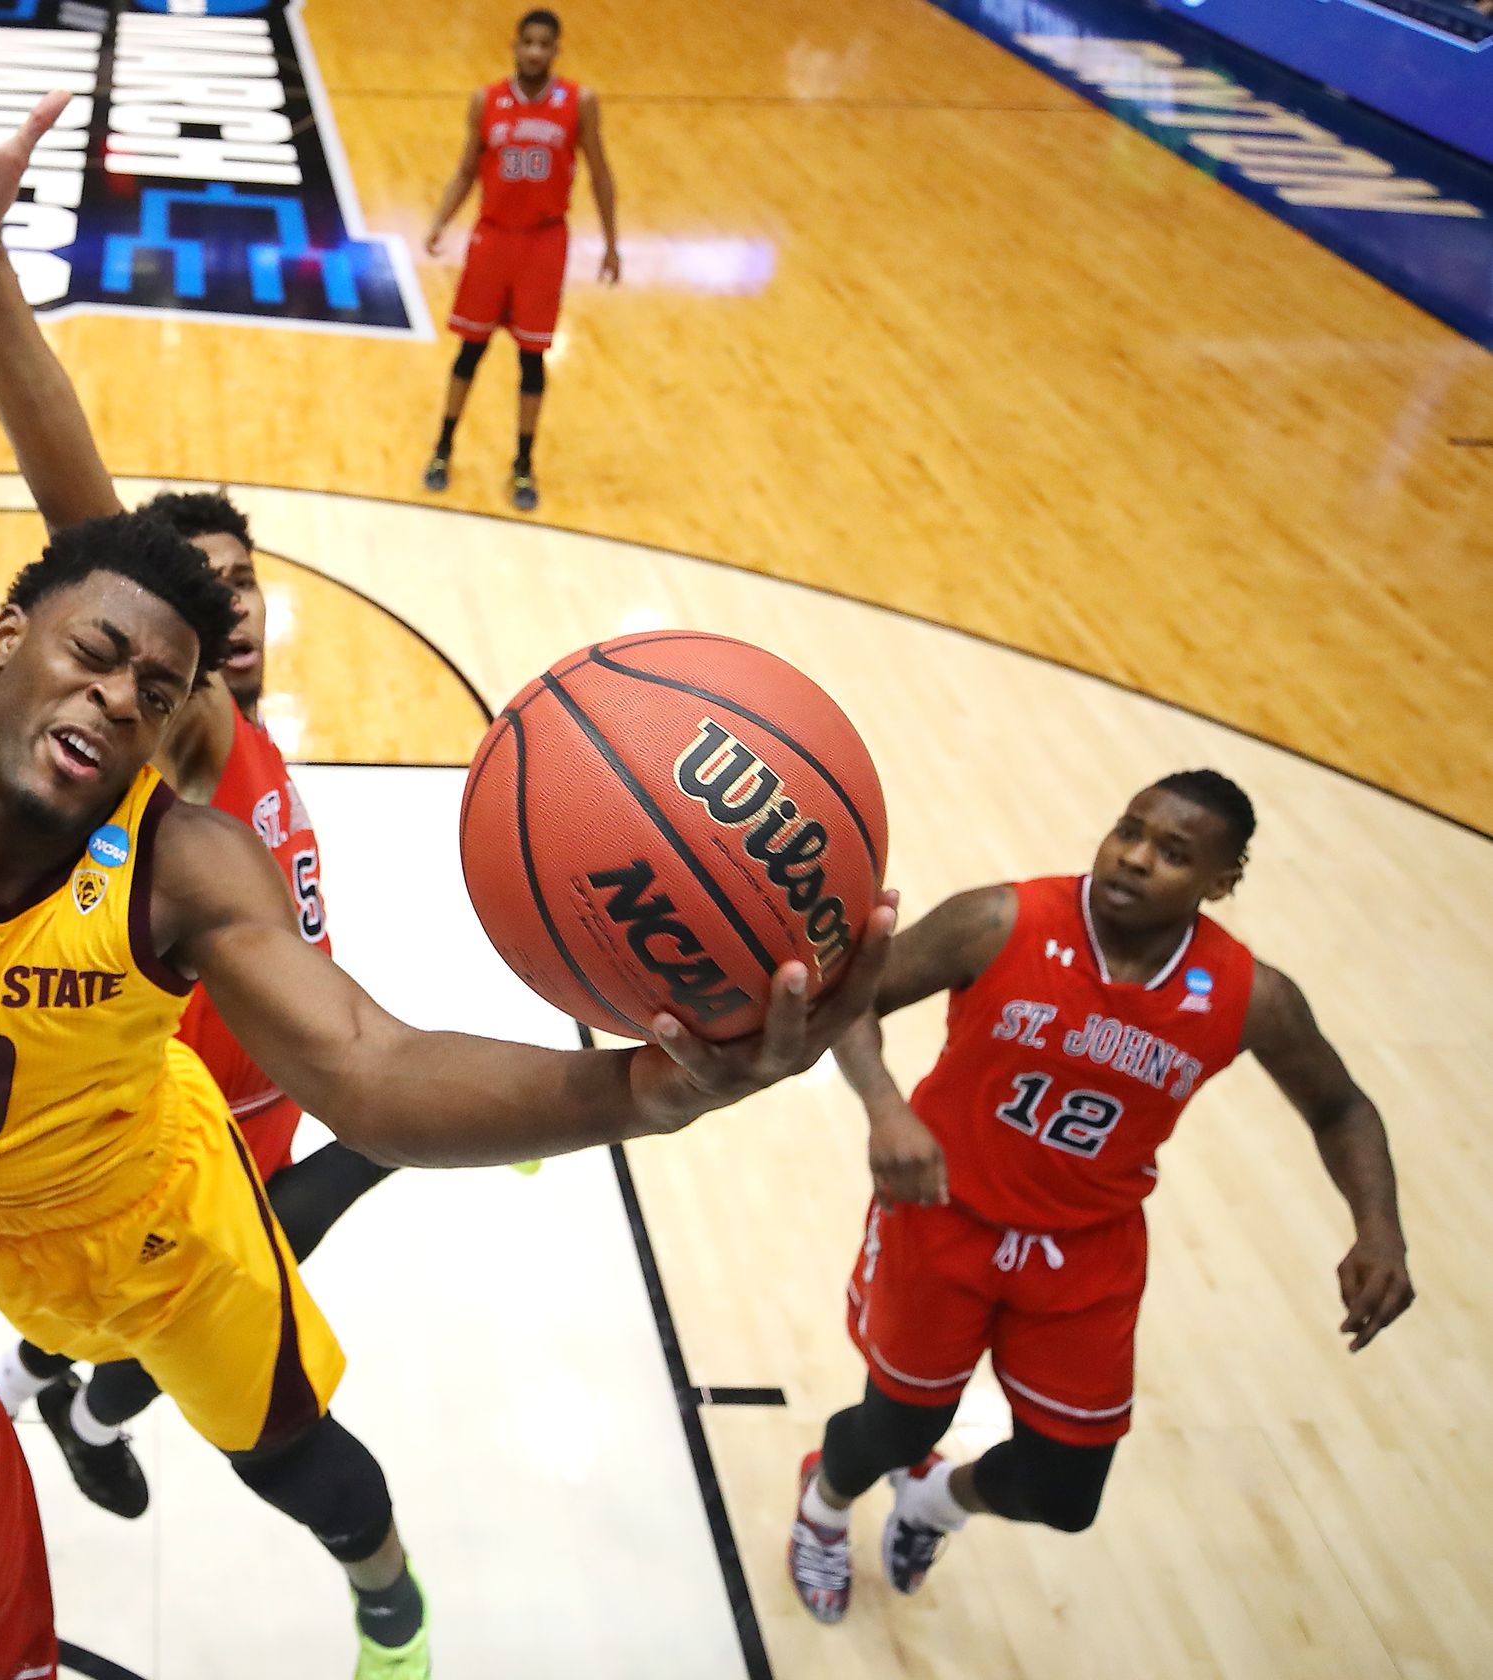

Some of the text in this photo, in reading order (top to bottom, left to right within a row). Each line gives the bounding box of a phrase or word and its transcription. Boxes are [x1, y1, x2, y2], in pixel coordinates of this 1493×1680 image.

[105, 11, 303, 186] MARCH
[498, 145, 552, 181] 30
[673, 716, 852, 984] Wilson
[0, 964, 128, 1009] STATE
[587, 859, 753, 1024] NCAA
[992, 1000, 1203, 1101] ST. JOHN'S
[996, 1071, 1124, 1159] 12
